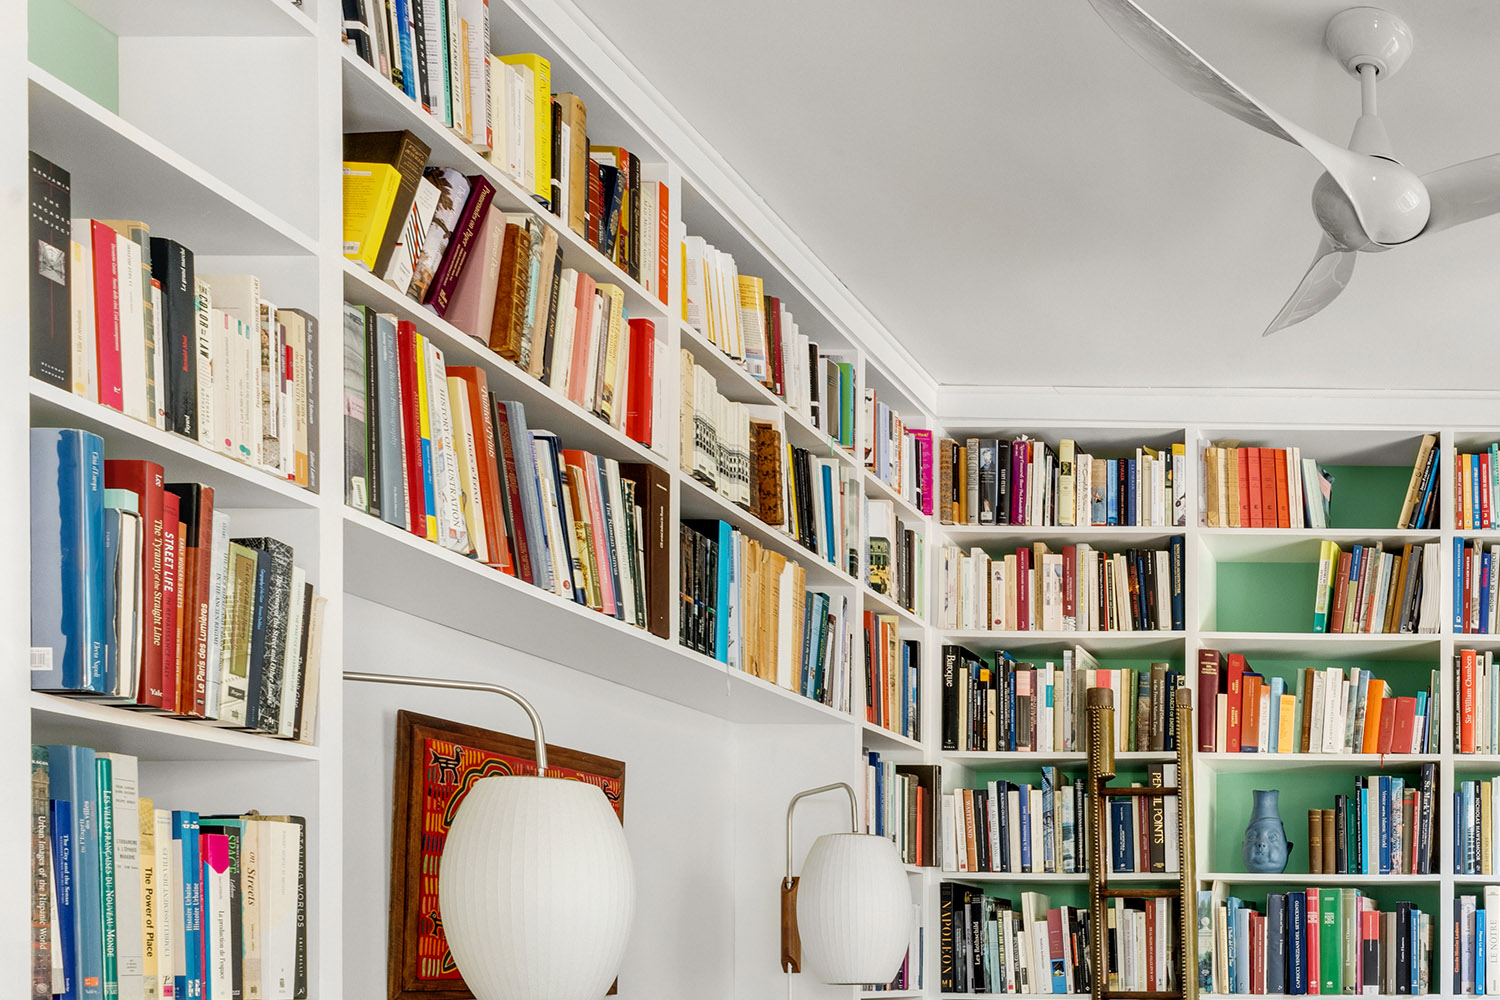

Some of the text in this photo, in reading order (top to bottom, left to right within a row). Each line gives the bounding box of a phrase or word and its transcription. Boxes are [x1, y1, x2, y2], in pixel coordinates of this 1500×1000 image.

[44, 196, 59, 208] THE
[472, 185, 490, 220] Promenades
[463, 229, 473, 247] Paper
[199, 295, 209, 359] COLOR LAW
[387, 334, 395, 348] The
[388, 373, 396, 396] Before
[439, 389, 450, 433] HISTORY
[446, 449, 459, 528] ILLUSTRATION
[152, 538, 162, 574] Tyranny
[164, 532, 174, 591] STREET LIFE
[153, 591, 162, 623] Straight
[154, 626, 162, 645] Line
[197, 644, 206, 658] des
[197, 661, 205, 681] Paris
[945, 655, 956, 687] Baroque
[150, 688, 163, 697] Yale
[1152, 772, 1163, 843] PENIL POINTS
[38, 816, 48, 949] Urban Images of the Hispanic World
[248, 868, 257, 906] Streets
[145, 887, 153, 917] Power
[146, 920, 153, 928] of
[217, 920, 225, 950] production
[942, 901, 952, 974] NAPOLEON
[146, 931, 154, 957] Place
[218, 958, 226, 979] l'espace
